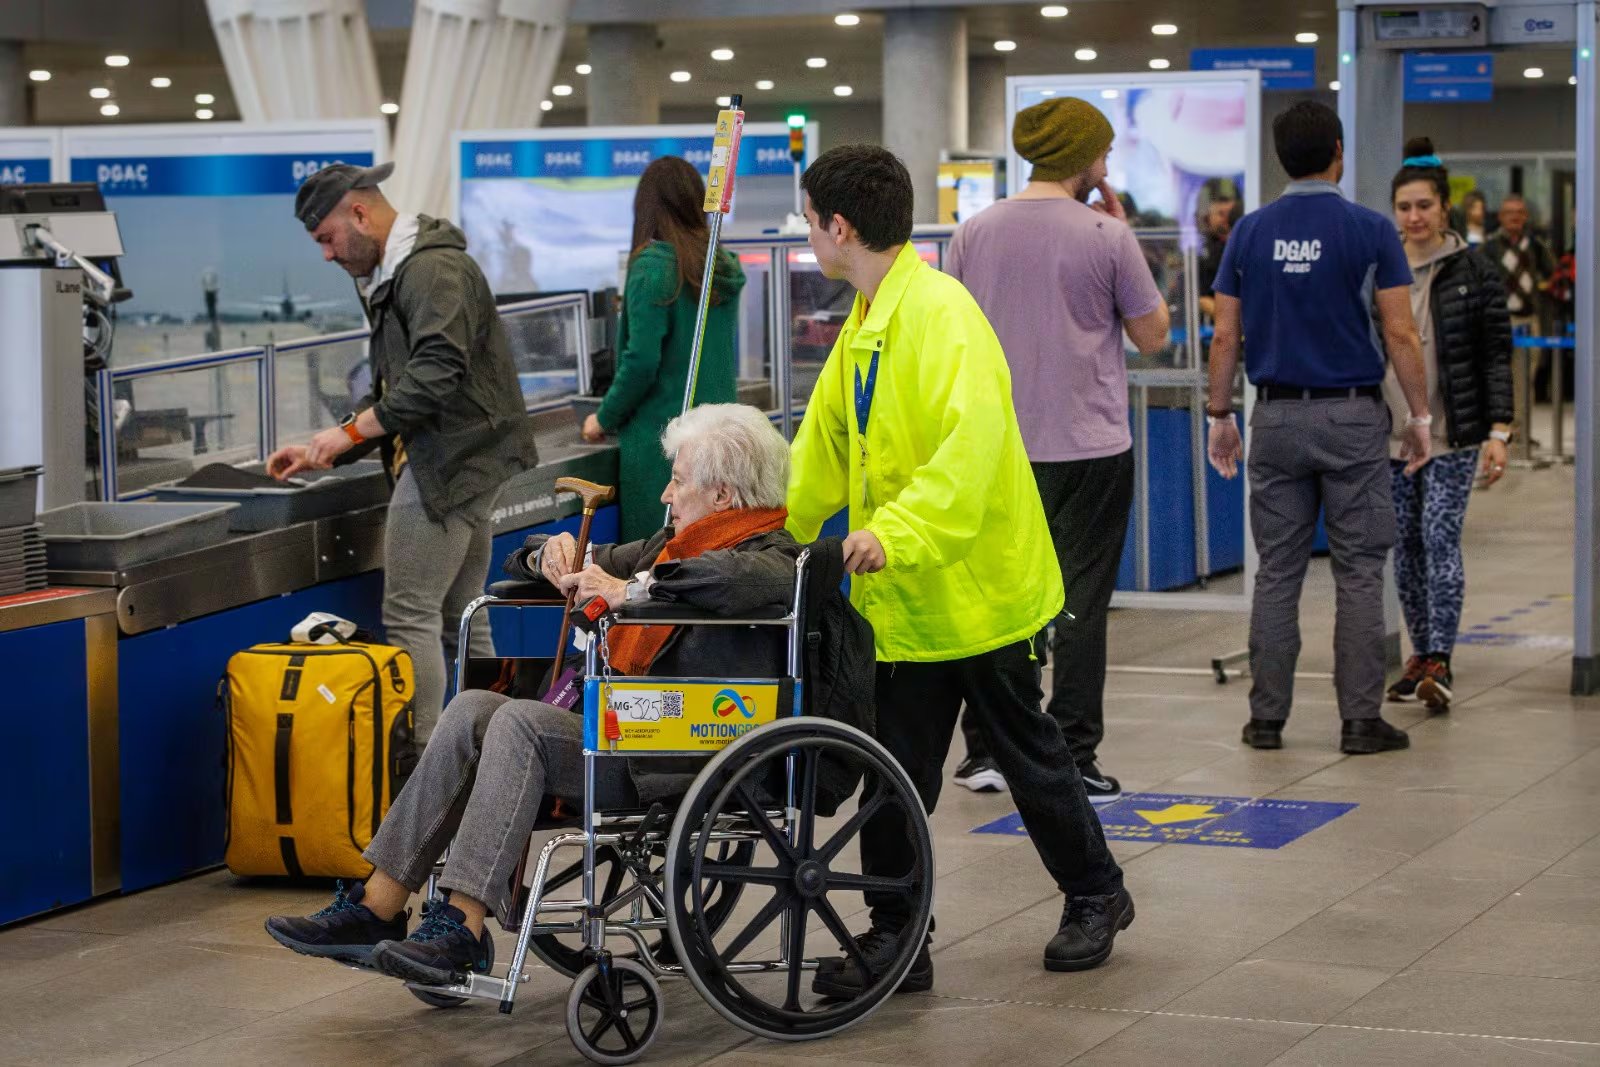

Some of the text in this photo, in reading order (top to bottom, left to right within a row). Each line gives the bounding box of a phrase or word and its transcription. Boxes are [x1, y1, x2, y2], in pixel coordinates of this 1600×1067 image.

[475, 152, 512, 167] DGAC
[545, 151, 581, 165] DGAC
[0, 166, 26, 184] AC
[97, 163, 149, 183] DGAC
[292, 160, 345, 180] DG
[1273, 239, 1322, 261] DGAC
[1282, 261, 1312, 273] AVSEC
[552, 690, 568, 705] THANK
[1199, 834, 1253, 843] SIGA
